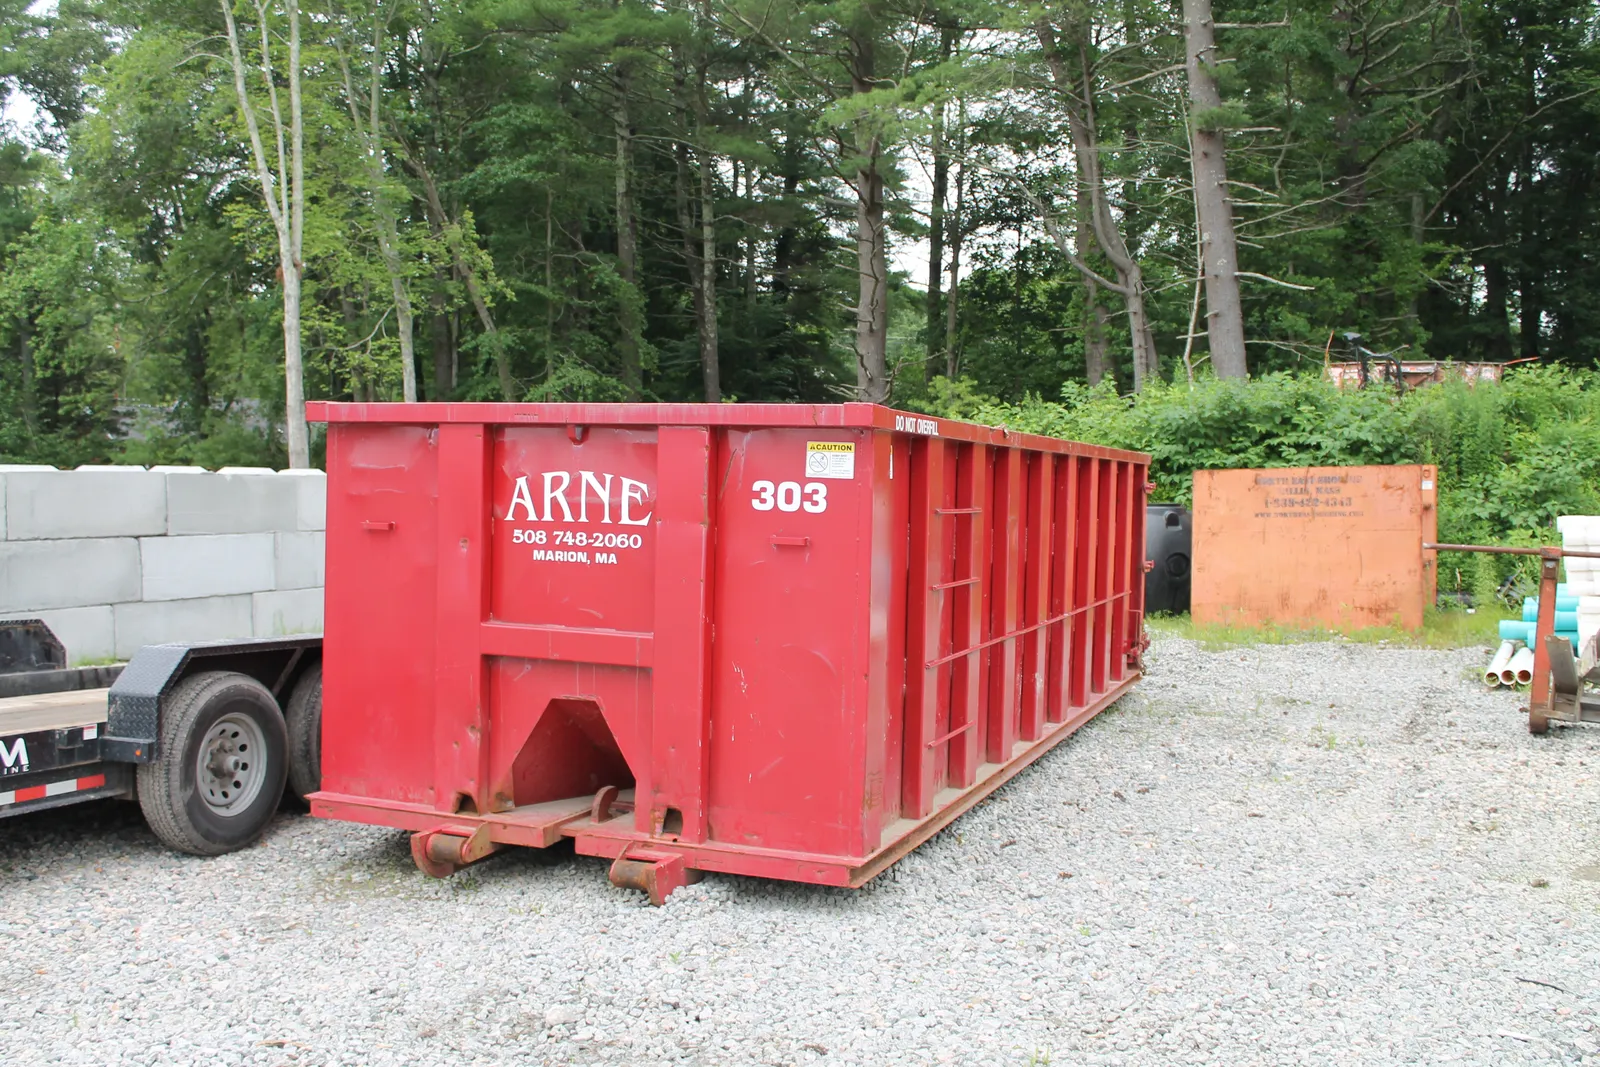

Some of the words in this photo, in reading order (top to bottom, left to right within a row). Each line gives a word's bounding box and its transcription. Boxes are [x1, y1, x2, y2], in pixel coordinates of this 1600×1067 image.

[896, 415, 904, 431] DO
[905, 417, 916, 433] NOT
[917, 418, 939, 436] OVERFILL
[504, 470, 652, 526] ARNE
[751, 480, 828, 514] 303
[512, 529, 547, 544] 508
[552, 530, 643, 549] 748-2060
[533, 550, 591, 565] MARION,
[595, 552, 618, 564] MA
